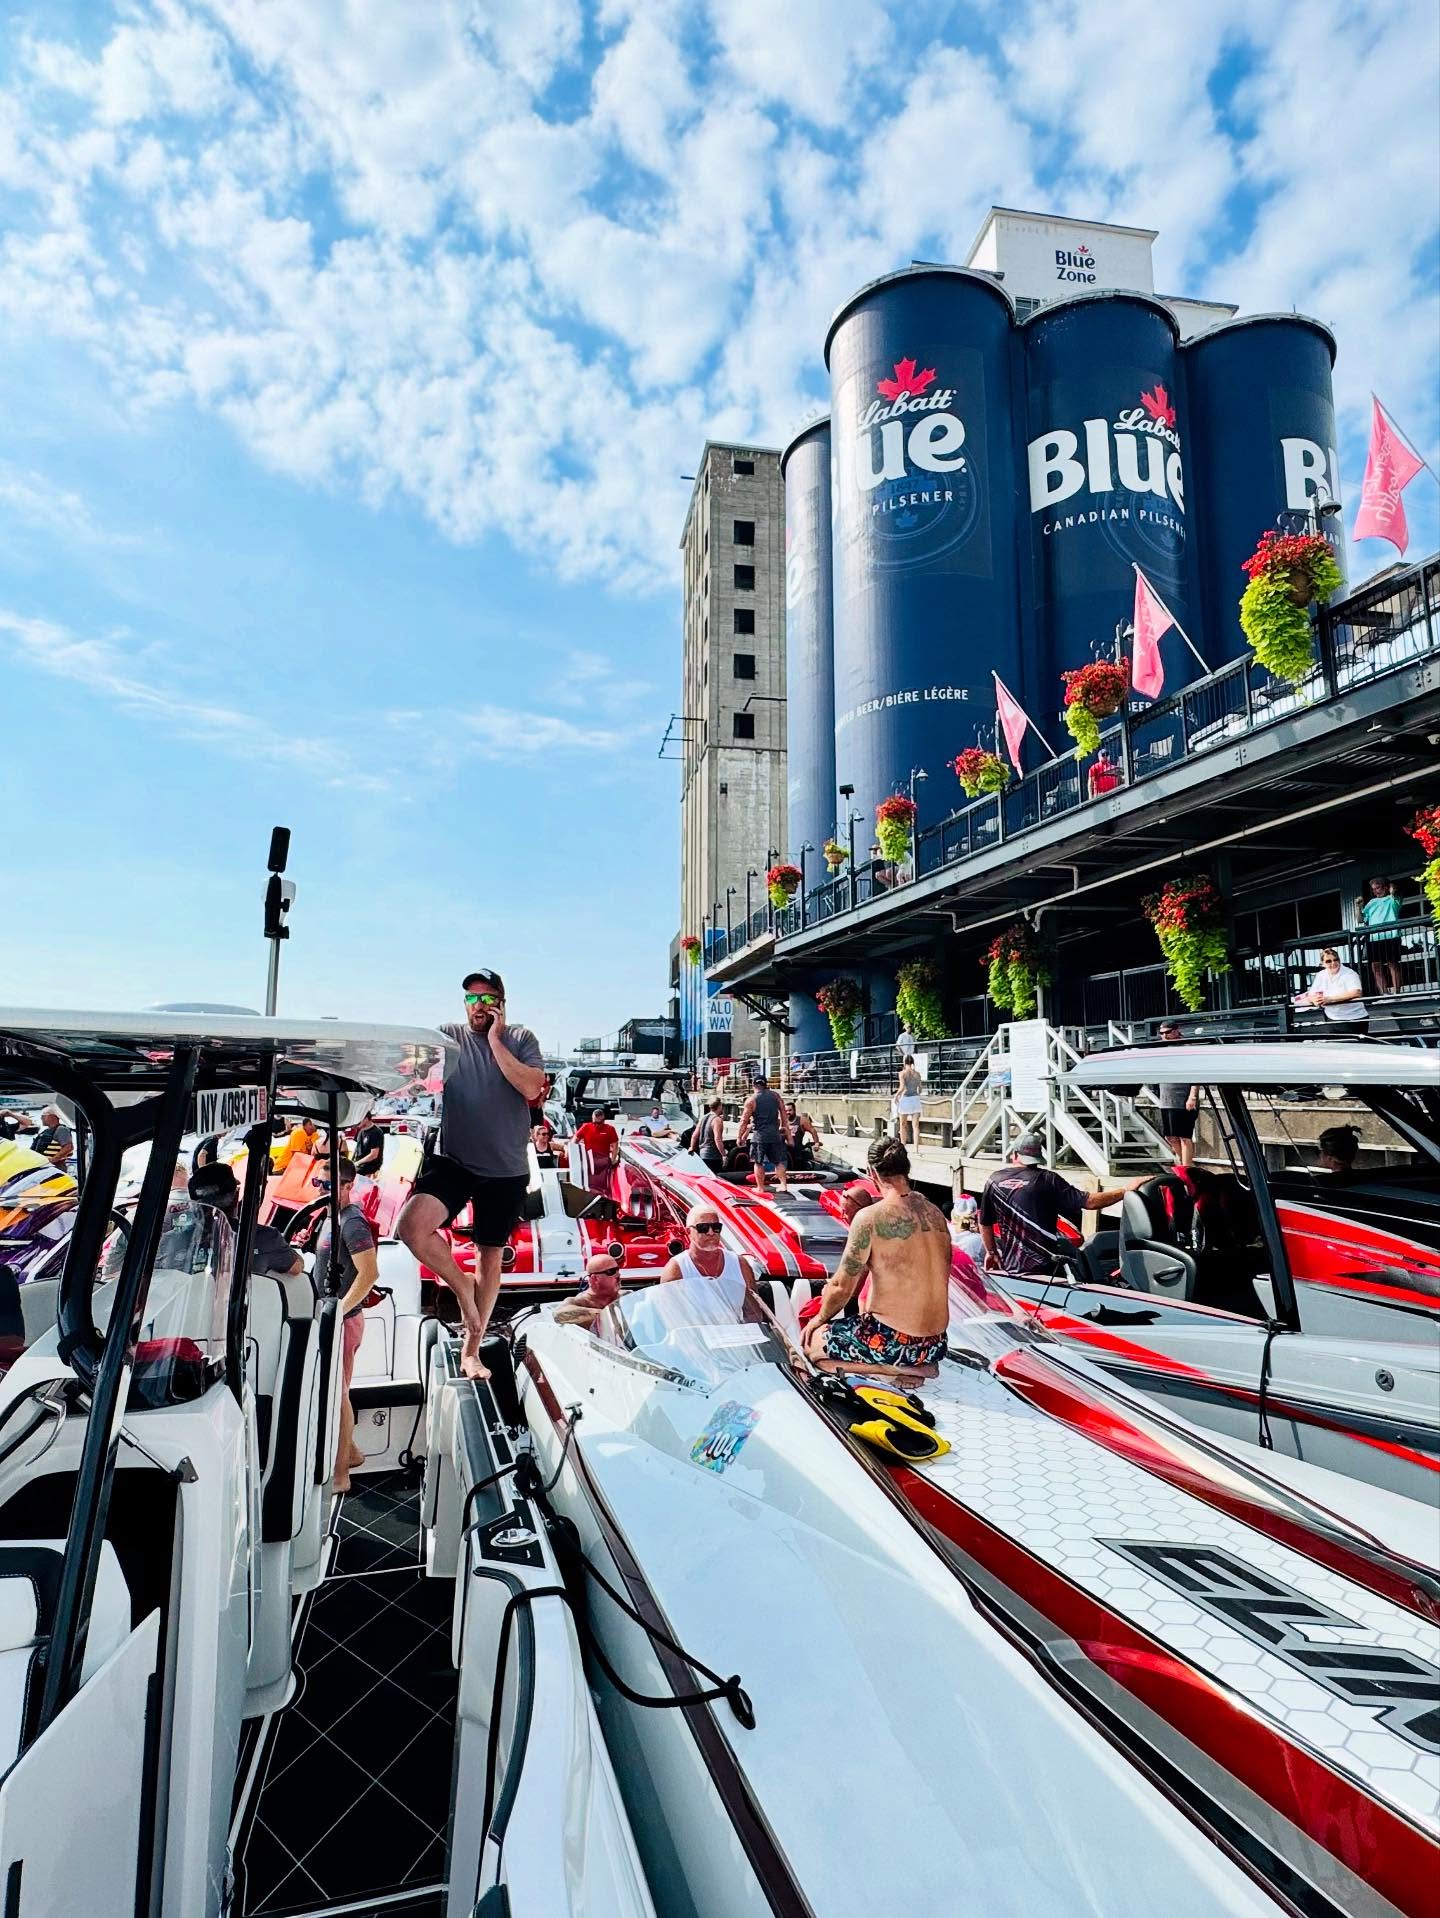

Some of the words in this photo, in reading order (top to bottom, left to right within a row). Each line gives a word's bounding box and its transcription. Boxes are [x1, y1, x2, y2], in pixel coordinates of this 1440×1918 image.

[1055, 250, 1095, 269] Blue
[1056, 267, 1096, 284] Zone
[872, 490, 953, 516] PILSENER
[1043, 508, 1130, 535] CANADIAN
[1139, 509, 1186, 541] PILSENE
[924, 686, 969, 701] LÉGÈRE
[709, 1016, 732, 1031] WAY
[201, 1093, 218, 1134] NY
[221, 1091, 247, 1129] 4093
[249, 1089, 259, 1123] FT
